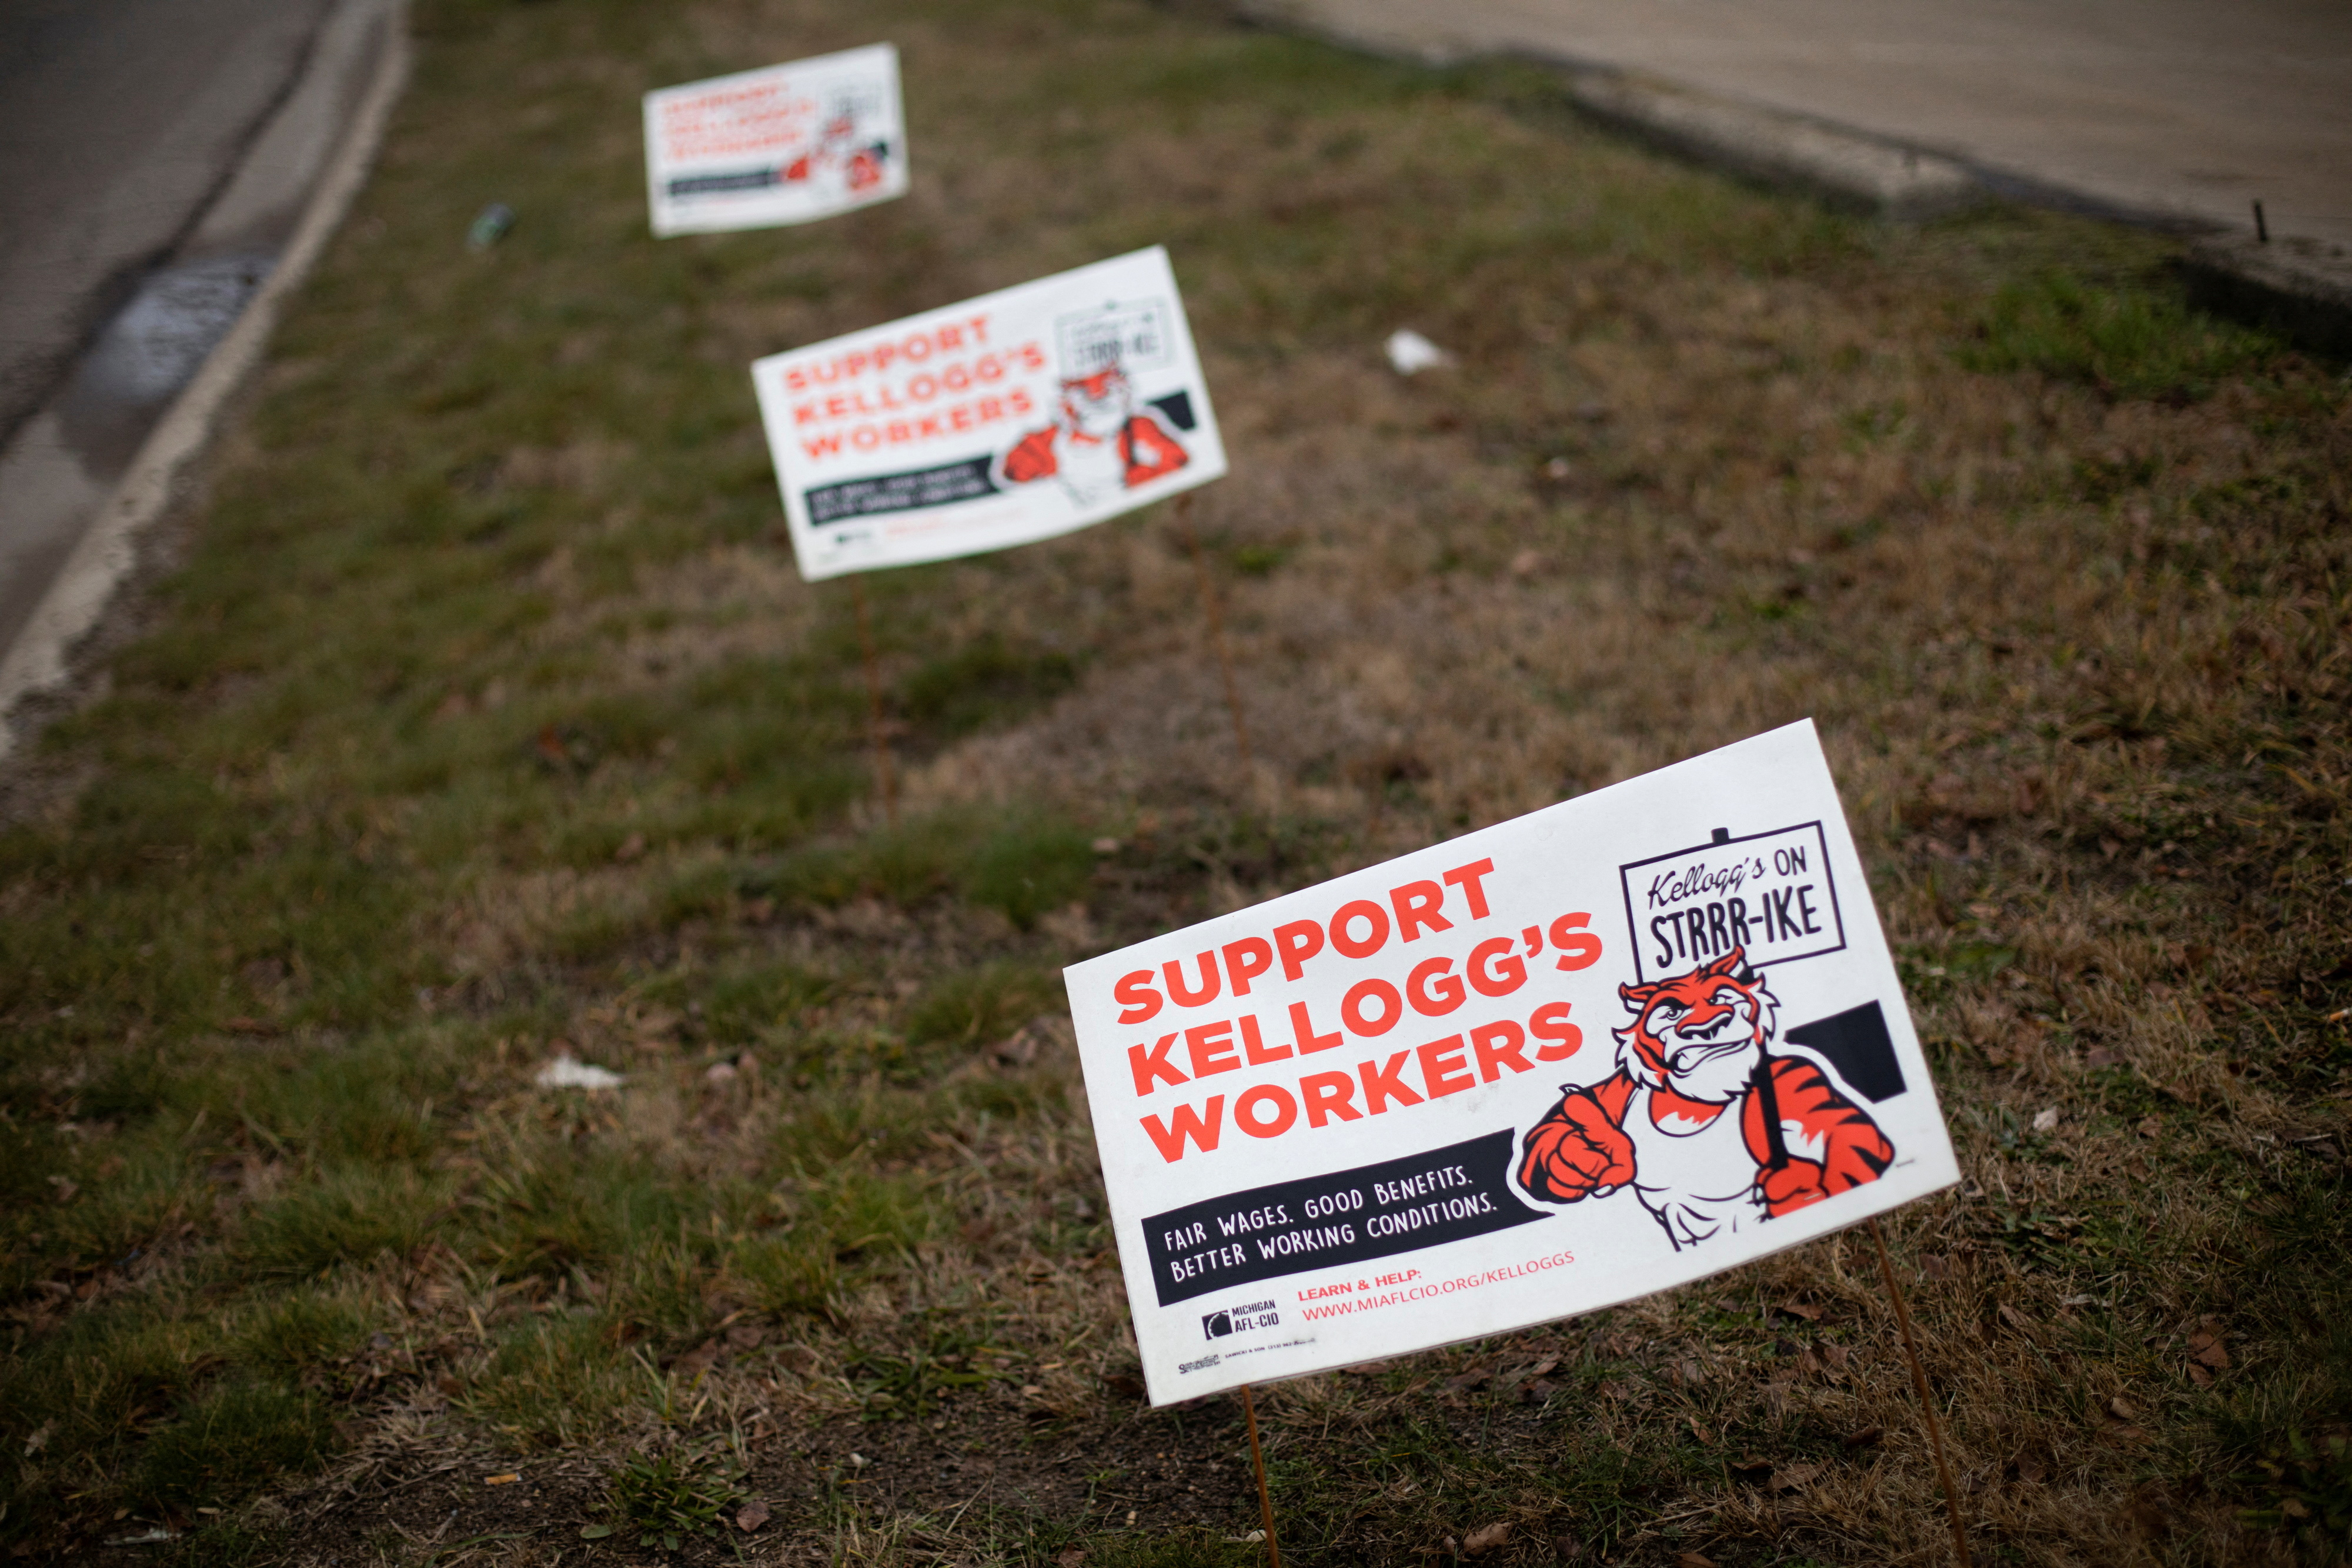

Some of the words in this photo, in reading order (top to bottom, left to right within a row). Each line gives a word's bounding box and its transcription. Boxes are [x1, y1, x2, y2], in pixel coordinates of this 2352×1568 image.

[783, 314, 992, 392] SUPPORT
[801, 388, 1034, 460] WORKERS
[1648, 857, 1766, 910] Kellogg's
[1774, 845, 1807, 877] ON
[1114, 857, 1494, 1025] SUPPORT
[1650, 884, 1822, 969] STRRR-IKE
[1127, 911, 1602, 1097] KELLOGG'S
[1139, 1001, 1583, 1164] WORKERS
[1164, 1223, 1207, 1251] FAIR
[1217, 1205, 1294, 1236] WAGES.
[1305, 1189, 1363, 1219] GOOD
[1374, 1165, 1473, 1205] BENEFITS.
[1170, 1243, 1247, 1282] BETTER
[1257, 1223, 1355, 1259] WORKING
[1367, 1192, 1498, 1238] CONDITIONS.
[1232, 1299, 1277, 1317] MICHIGAN
[1235, 1312, 1279, 1332] AFL-CIO
[1297, 1282, 1352, 1302] LEARN
[1357, 1279, 1371, 1291] &
[1374, 1269, 1422, 1287] HELP:
[1302, 1251, 1575, 1322] WWW.MIAFLCIO.ORG/KELLOGGS
[1224, 1350, 1247, 1359] SAWICKI
